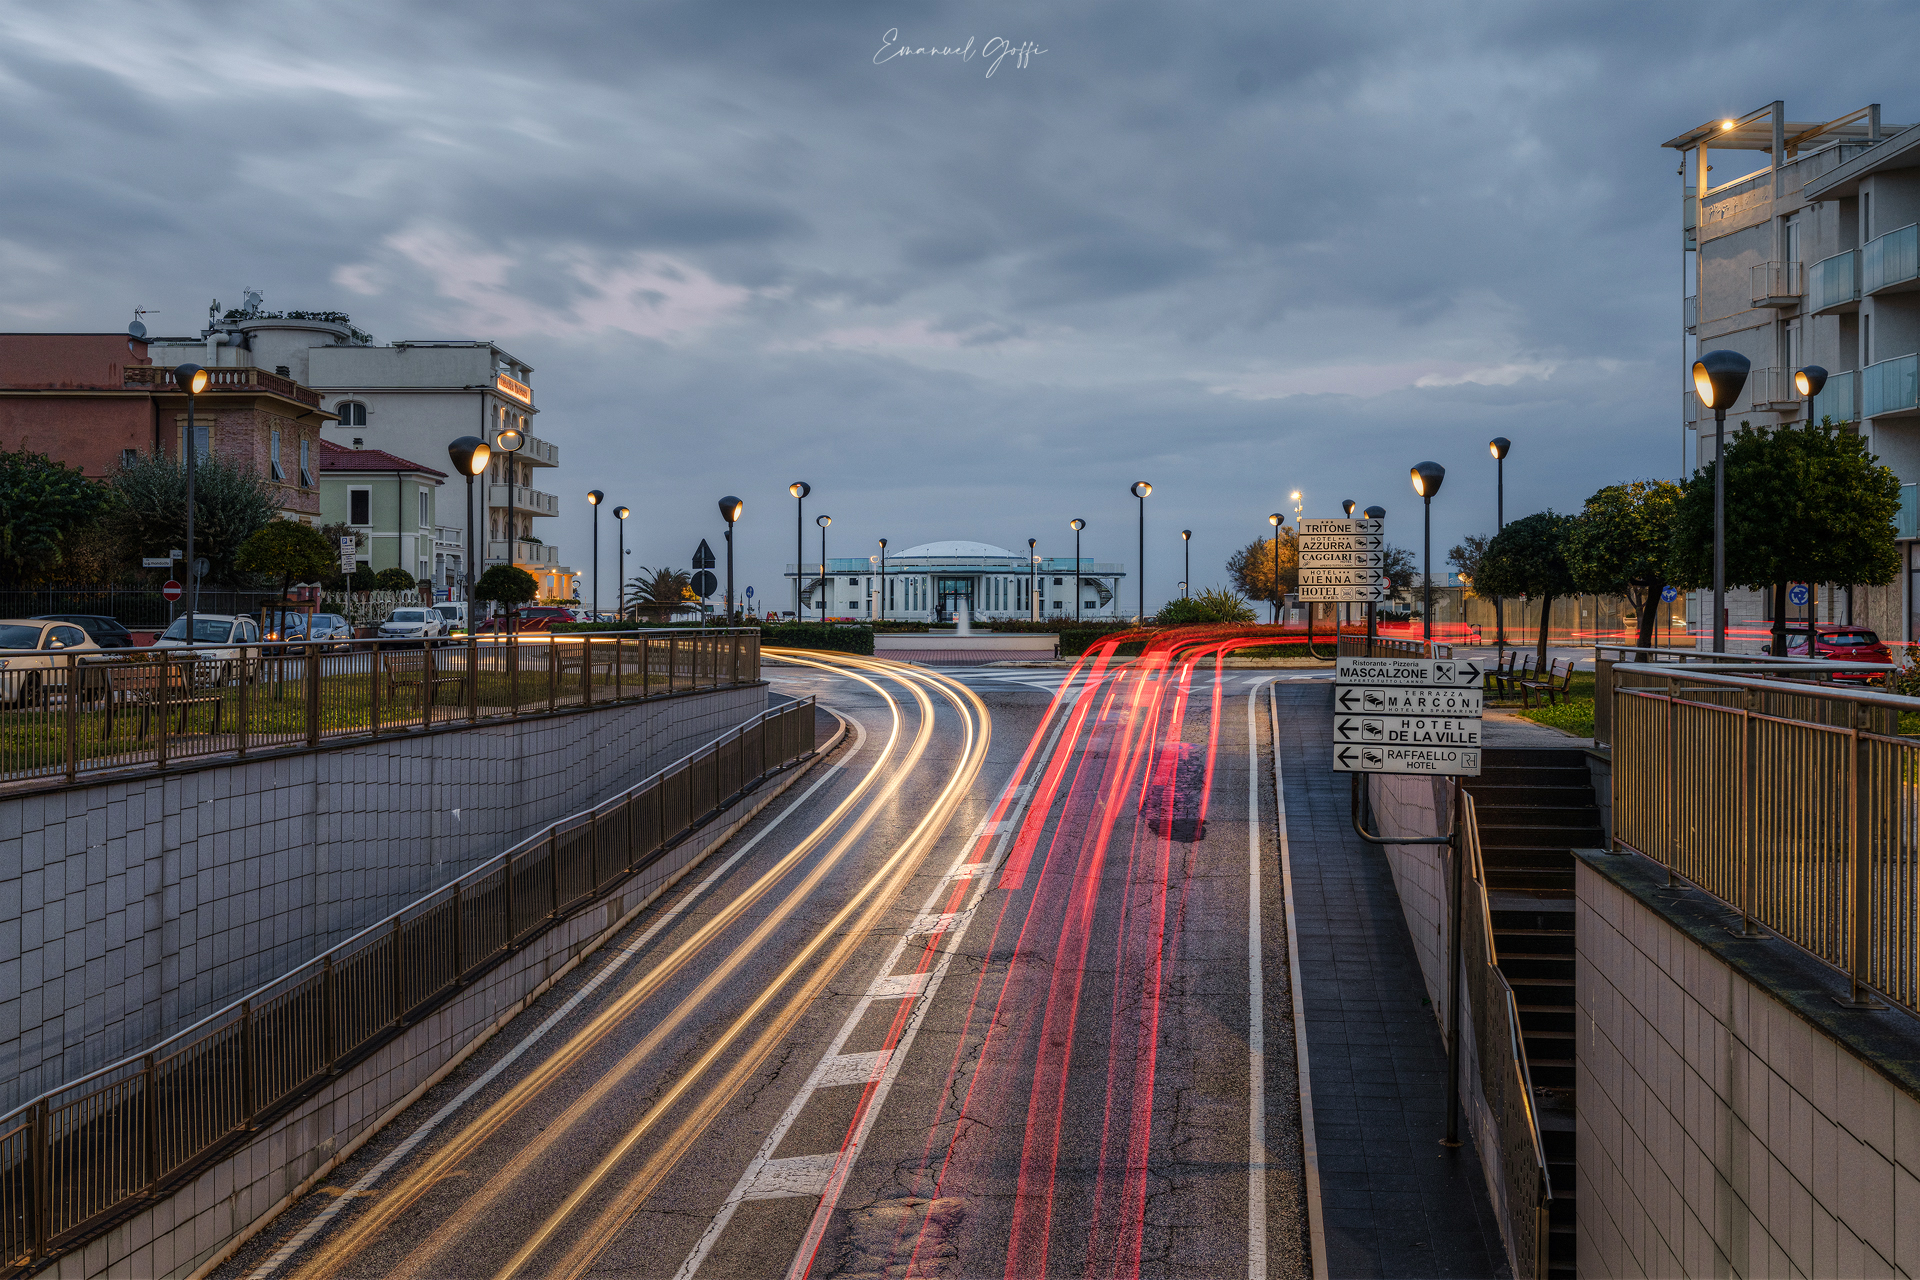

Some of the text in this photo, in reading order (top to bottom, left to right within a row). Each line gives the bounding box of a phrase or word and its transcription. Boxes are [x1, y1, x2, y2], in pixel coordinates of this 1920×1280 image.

[1305, 524, 1352, 533] TRITONE
[1302, 542, 1352, 550] AZZURRA
[1301, 587, 1340, 596] HOTEL
[1340, 667, 1428, 679] MASCALZONE
[1388, 696, 1480, 708] MARCONI
[1401, 719, 1465, 731] HOTEL
[1388, 730, 1477, 744] DE LA VILLE
[1387, 749, 1457, 762] RAFFAELLO
[1406, 761, 1437, 770] HOTEL
